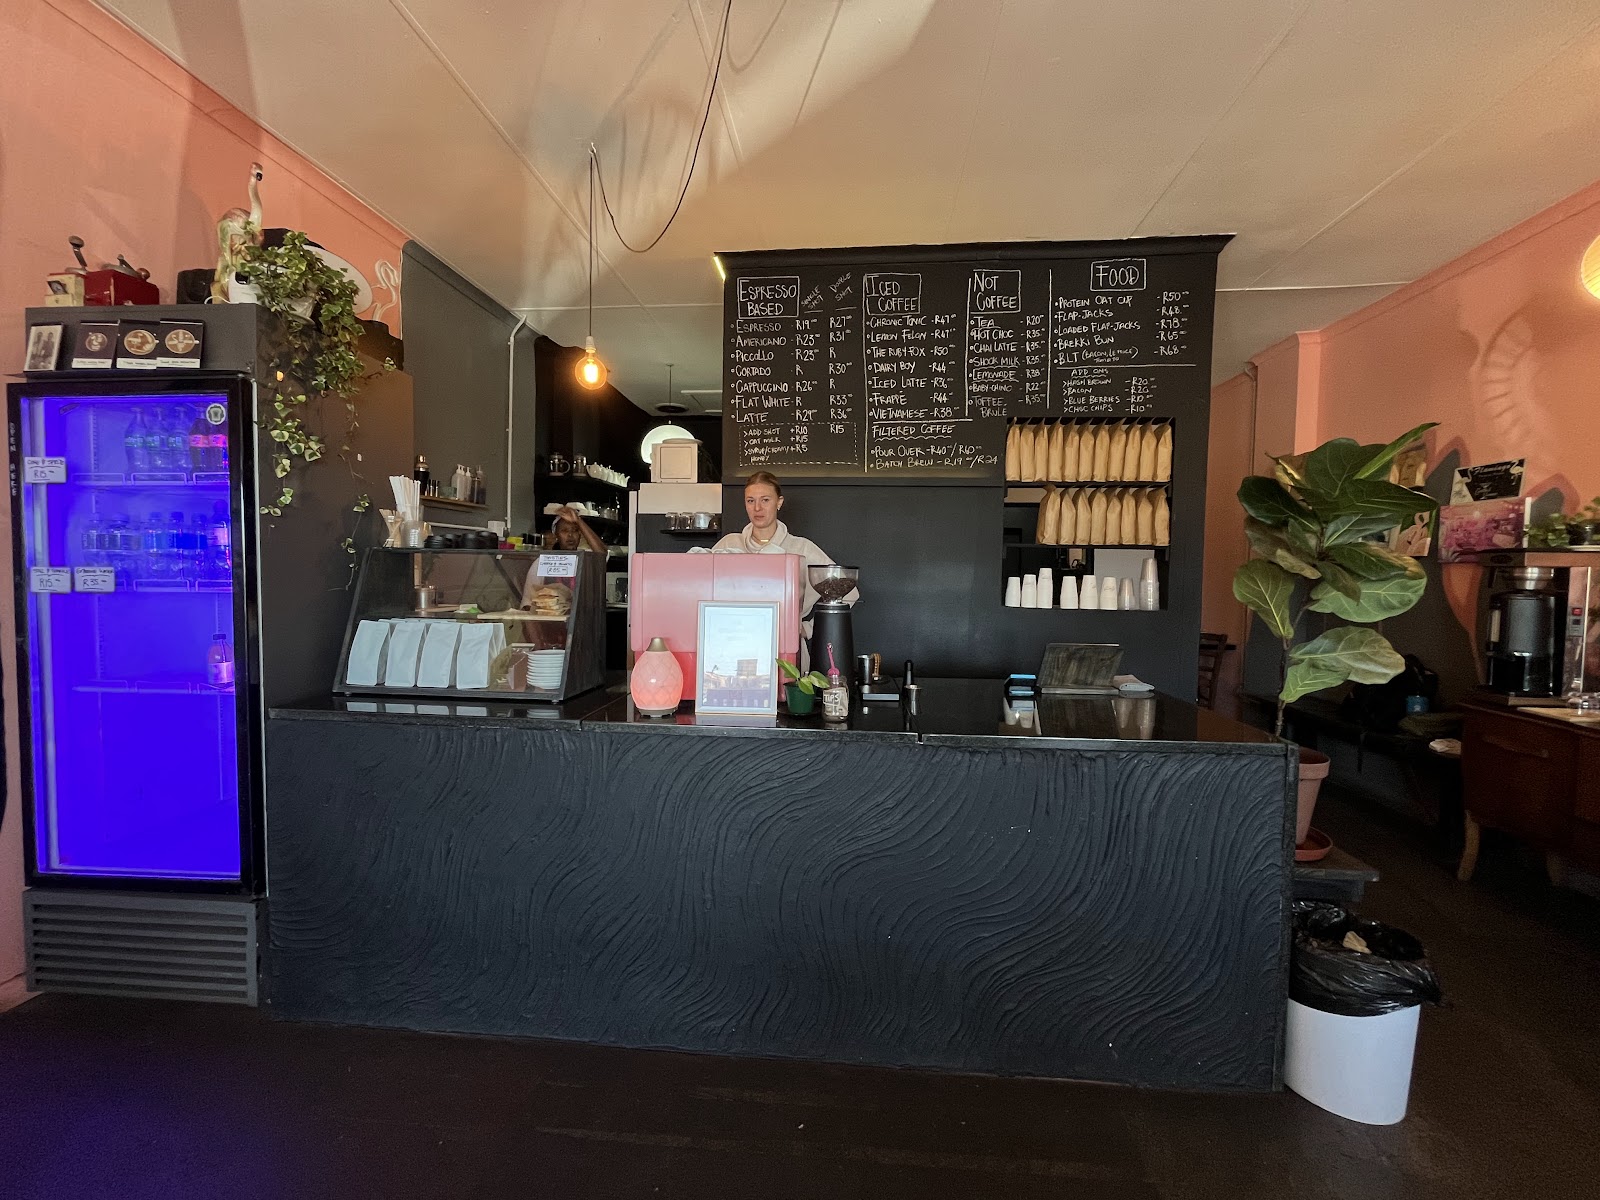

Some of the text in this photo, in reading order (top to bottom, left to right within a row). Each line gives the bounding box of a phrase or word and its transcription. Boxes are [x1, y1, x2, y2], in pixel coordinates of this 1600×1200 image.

[974, 272, 999, 292] NOT
[1096, 265, 1139, 287] FOOD
[740, 280, 797, 301] ESPRESSO
[867, 275, 901, 296] ICED
[878, 297, 918, 312] COFFEE
[976, 292, 1018, 311] COFFEE
[1059, 297, 1090, 309] PROTEIN
[1095, 295, 1113, 305] OAT
[747, 302, 784, 316] BASED
[736, 320, 782, 333] ESPRESSO
[973, 316, 995, 327] TEA
[992, 329, 1014, 339] CHOC
[1058, 324, 1089, 336] LOADED
[735, 335, 787, 347] AMERICANO
[871, 331, 898, 342] LEMON
[1093, 335, 1115, 346] BUN
[871, 346, 887, 358] THE
[994, 341, 1018, 352] LATTE
[1001, 356, 1021, 366] MILK
[1058, 351, 1080, 365] BLT
[735, 365, 772, 377] CORTADO
[900, 361, 916, 373] BOY
[972, 369, 1017, 380] LEMONADE
[872, 376, 897, 388] ICED
[901, 376, 927, 388] LATTE
[1067, 387, 1092, 396] BACON
[735, 395, 760, 409] FLAT
[762, 395, 791, 408] WHITE
[736, 411, 769, 422] LATTE
[872, 408, 929, 419] VIETNAMESE
[872, 424, 956, 438] FILTERED COFFEE
[875, 445, 896, 457] POUR
[898, 445, 926, 457] OVER
[875, 458, 903, 470] BATCH
[908, 457, 933, 468] BREW
